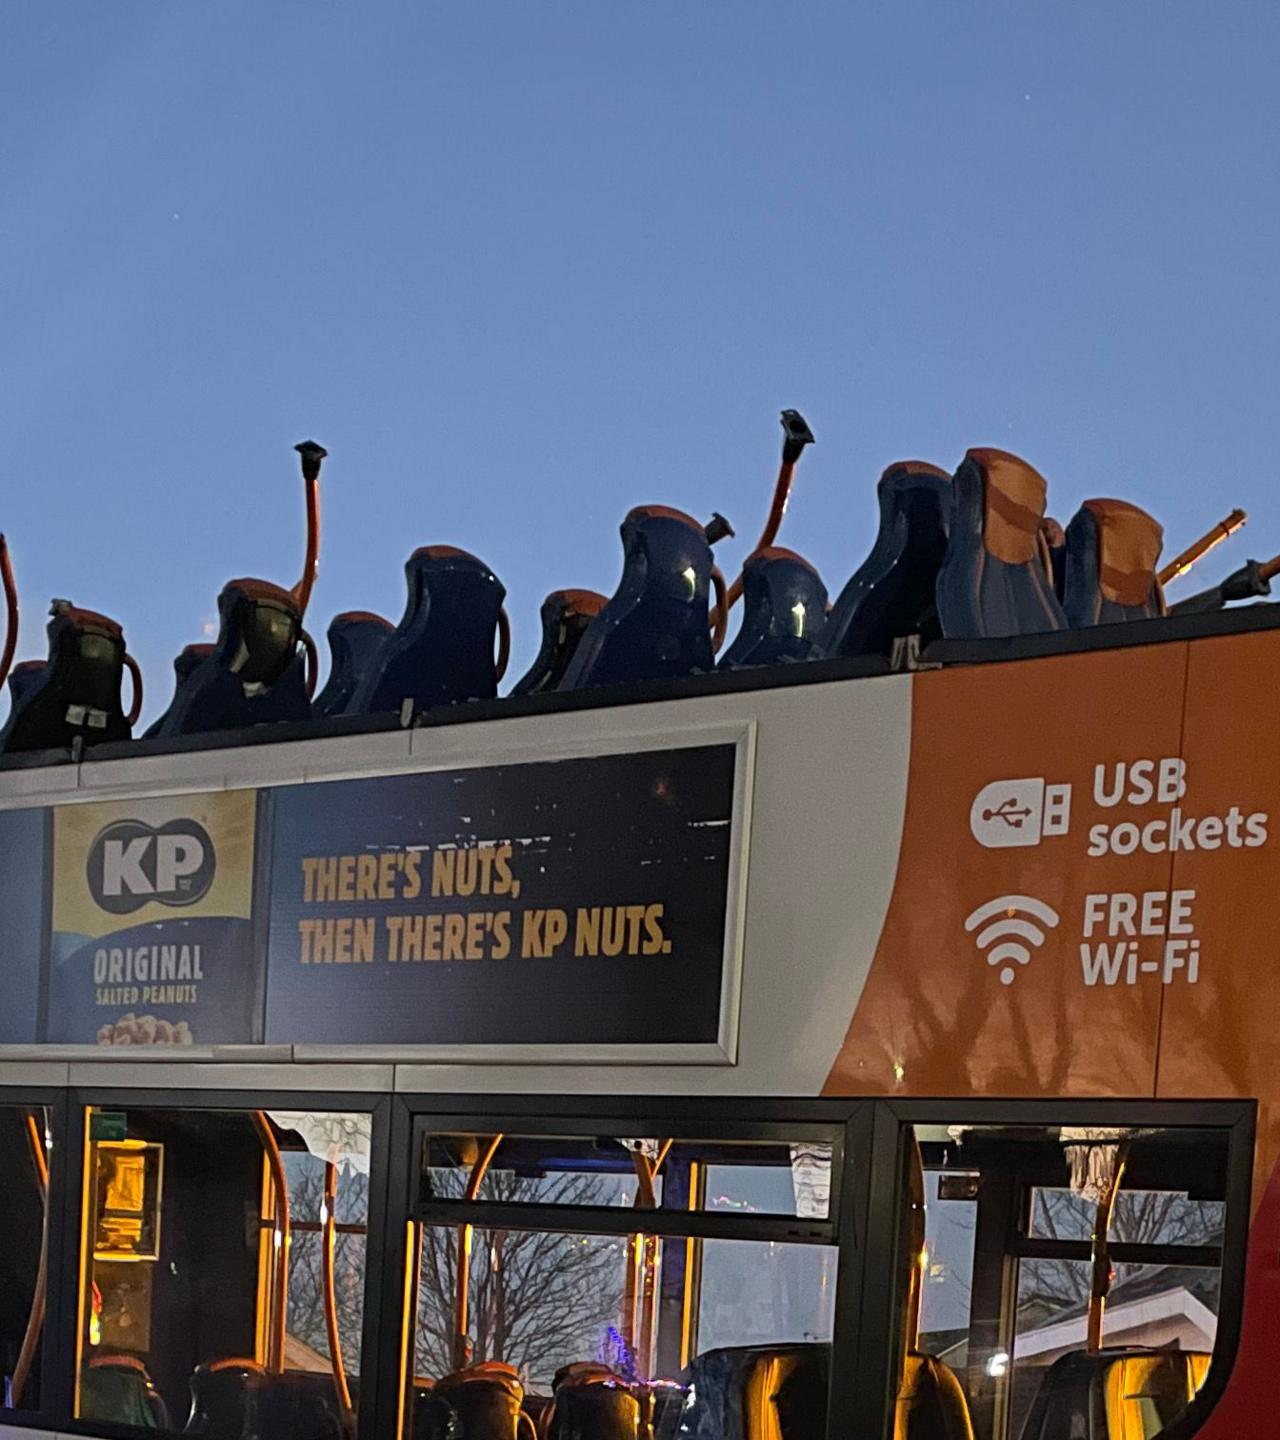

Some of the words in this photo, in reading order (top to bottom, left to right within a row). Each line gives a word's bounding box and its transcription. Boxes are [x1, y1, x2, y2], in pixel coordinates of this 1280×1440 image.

[1093, 757, 1187, 807] USB
[1087, 806, 1269, 857] sockets
[103, 834, 204, 896] KP
[302, 853, 422, 902] THERE'S
[431, 846, 521, 899] NUTS,
[299, 917, 375, 964] THEN
[386, 911, 511, 962] THERE'S
[521, 909, 568, 958] KP
[574, 904, 672, 957] NUTS.
[1083, 889, 1195, 938] FREE
[94, 945, 204, 984] ORIGINAL
[1080, 939, 1200, 986] Wi-Fi
[96, 988, 138, 1006] SALTED
[143, 985, 197, 1004] PEANUTS
